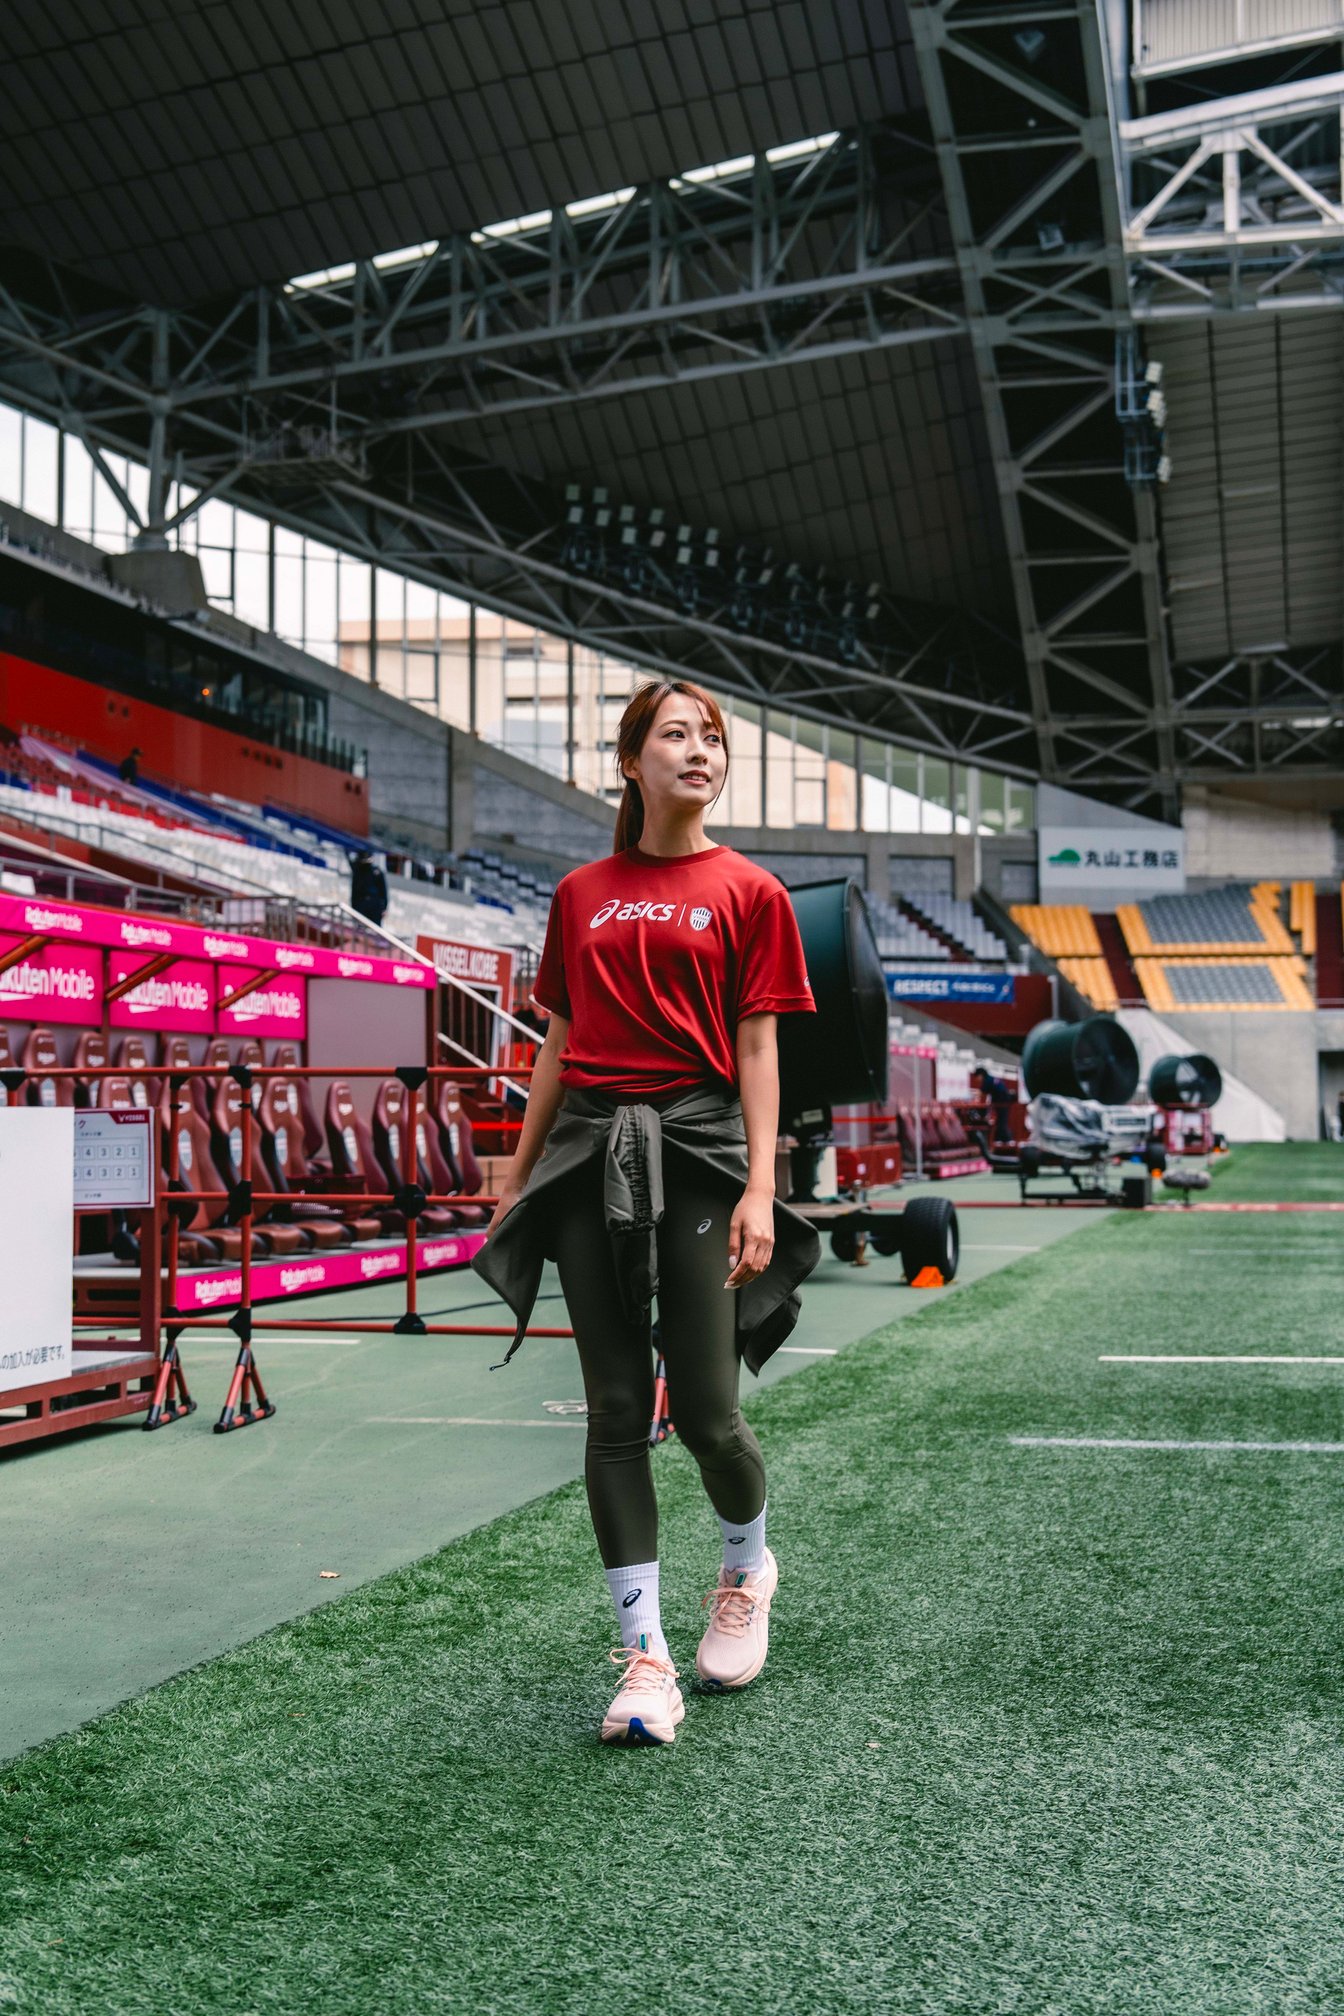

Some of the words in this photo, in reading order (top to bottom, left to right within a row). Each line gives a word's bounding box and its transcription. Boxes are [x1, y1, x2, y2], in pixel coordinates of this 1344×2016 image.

[1085, 850, 1178, 868] 丸山工務店
[616, 901, 677, 921] asics
[49, 967, 95, 1000] Mobile
[171, 981, 208, 1011] Mobile
[0, 1345, 65, 1370] の加入が必要です。
